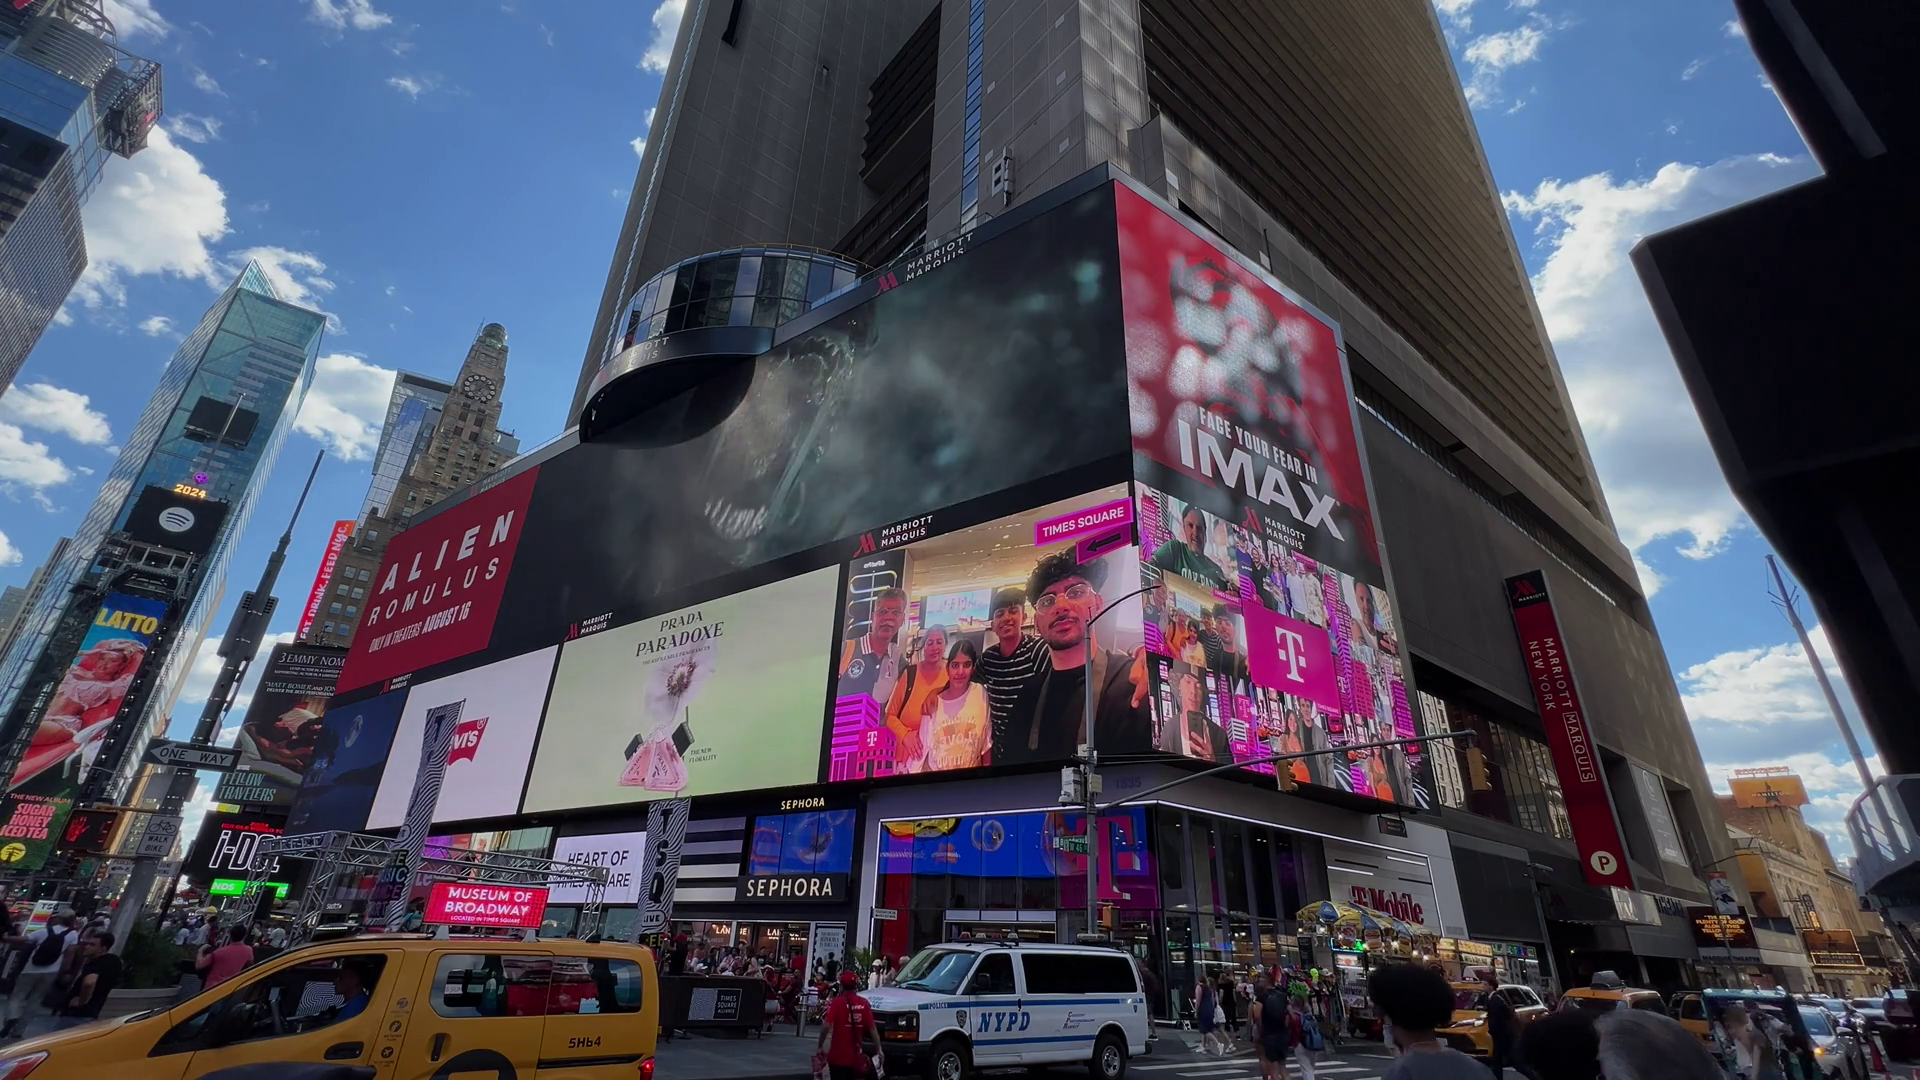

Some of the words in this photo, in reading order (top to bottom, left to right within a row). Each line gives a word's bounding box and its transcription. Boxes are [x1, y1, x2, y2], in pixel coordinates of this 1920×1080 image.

[907, 232, 973, 271] MARRIOTT
[906, 248, 964, 281] MARQUIS
[1199, 407, 1232, 440] FACE
[1235, 425, 1270, 459] YOUR
[1272, 445, 1303, 476] FEAR
[1304, 462, 1318, 485] IN
[1178, 419, 1345, 542] IMAX
[174, 484, 206, 498] 2024
[881, 515, 933, 537] MARRIOTT
[1042, 521, 1075, 537] TIMES
[1077, 506, 1124, 530] SQUARE
[1265, 516, 1306, 541] MARRIOTT
[881, 527, 927, 547] MARQUIS
[1266, 527, 1303, 549] MARQUIS
[379, 510, 514, 594] ALIEN
[321, 553, 338, 578] FEED
[368, 558, 499, 626] ROMULUS
[1519, 592, 1545, 602] MARRIOTT
[97, 607, 158, 635] LATTO
[391, 621, 422, 645] THEATERS
[421, 605, 460, 634] AUGUST
[458, 601, 472, 621] 16
[580, 621, 607, 635] MARQUIS
[582, 612, 613, 626] MARRIOTT
[660, 611, 704, 632] PRADA
[636, 622, 724, 657] PARADOXE
[279, 653, 287, 663] 3
[287, 654, 317, 664] EMMY
[1528, 641, 1545, 670] NEW
[1538, 674, 1557, 711] YORK
[1544, 637, 1573, 708] MARRIOTT
[1565, 713, 1594, 781] MARQUIS
[160, 748, 188, 760] ONE
[200, 752, 228, 764] WAY
[223, 772, 265, 786] FELLOW
[219, 785, 276, 802] TRAVELERS
[781, 797, 825, 810] SEPHORA
[14, 803, 56, 817] SUGAR
[9, 814, 52, 828] HONEY
[0, 825, 27, 838] ICED
[27, 827, 49, 839] TEA
[145, 844, 163, 853] BIKE
[611, 850, 629, 866] OF
[1598, 855, 1611, 871] P
[448, 887, 508, 901] MUSEUM
[514, 891, 532, 902] OF
[746, 878, 832, 896] SEPHORA
[445, 902, 530, 916] BROADWAY
[978, 1012, 1030, 1033] NYPD
